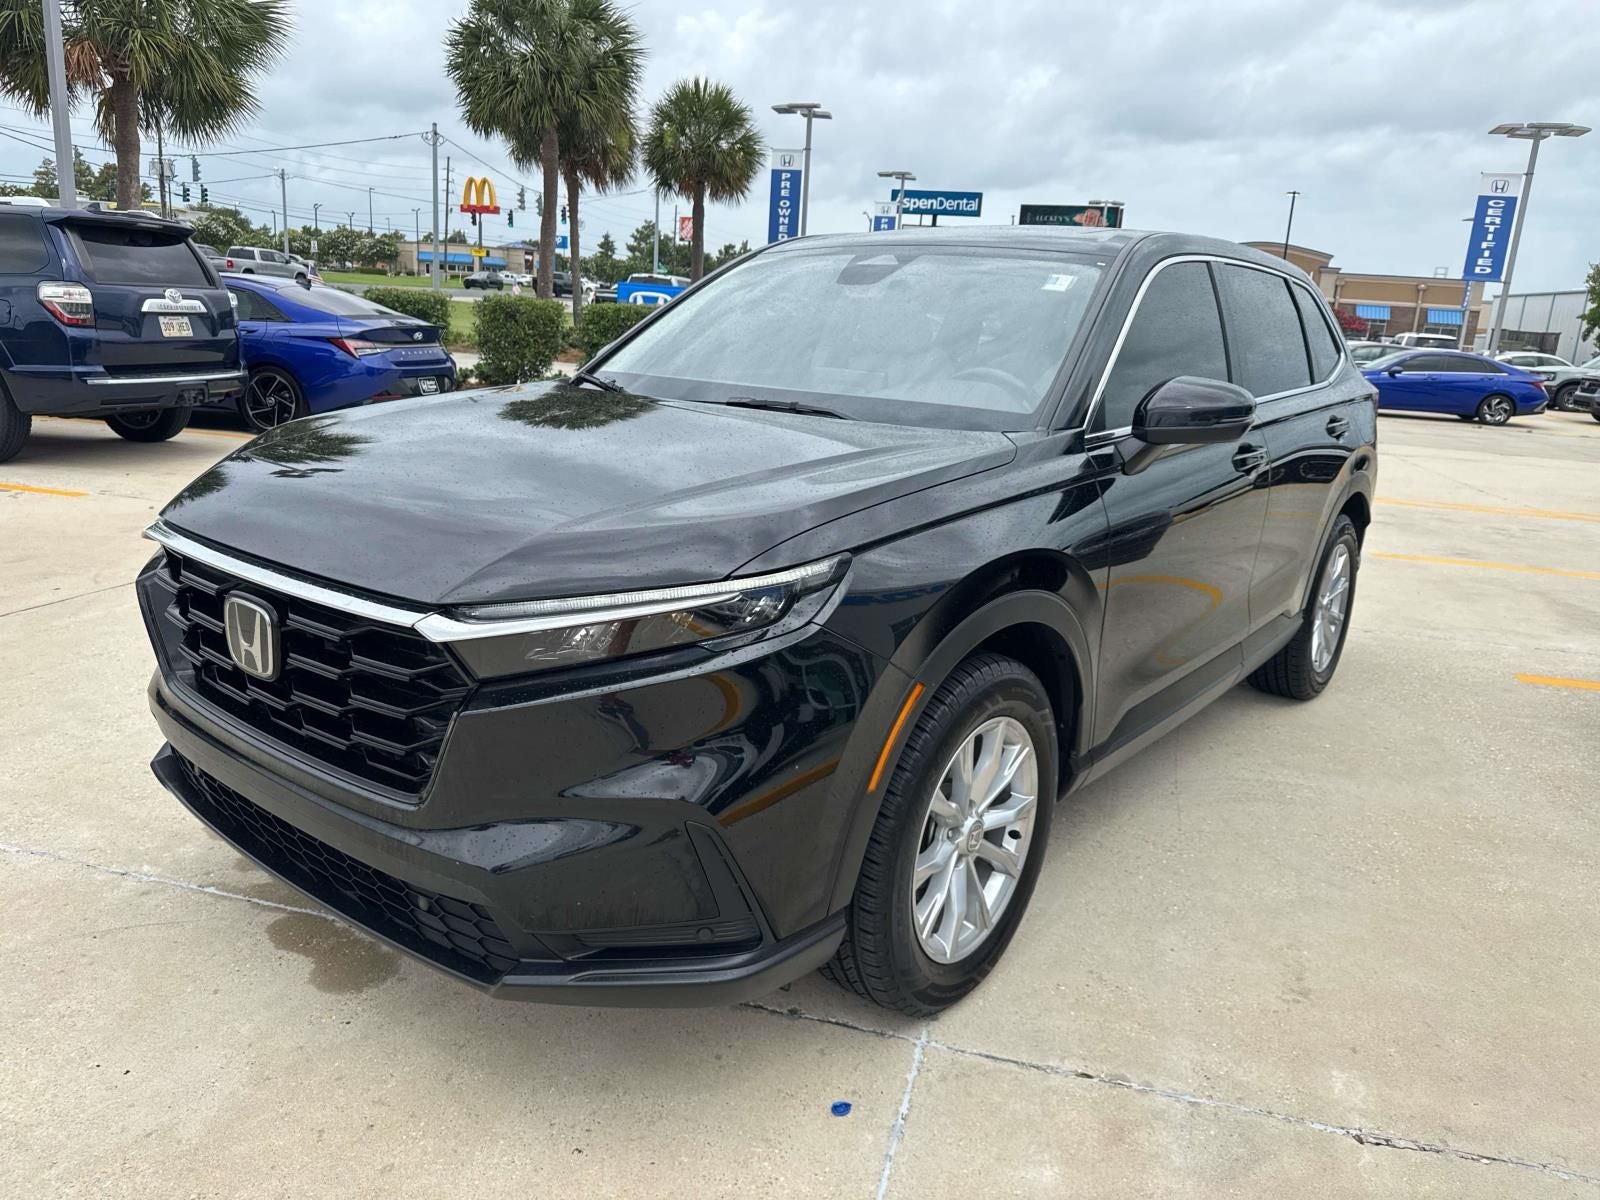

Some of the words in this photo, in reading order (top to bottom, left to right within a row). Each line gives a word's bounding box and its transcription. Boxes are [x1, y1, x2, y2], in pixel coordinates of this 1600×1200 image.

[780, 172, 791, 197] PRE
[778, 200, 791, 241] OWNED
[1474, 199, 1506, 274] CERTIFIED
